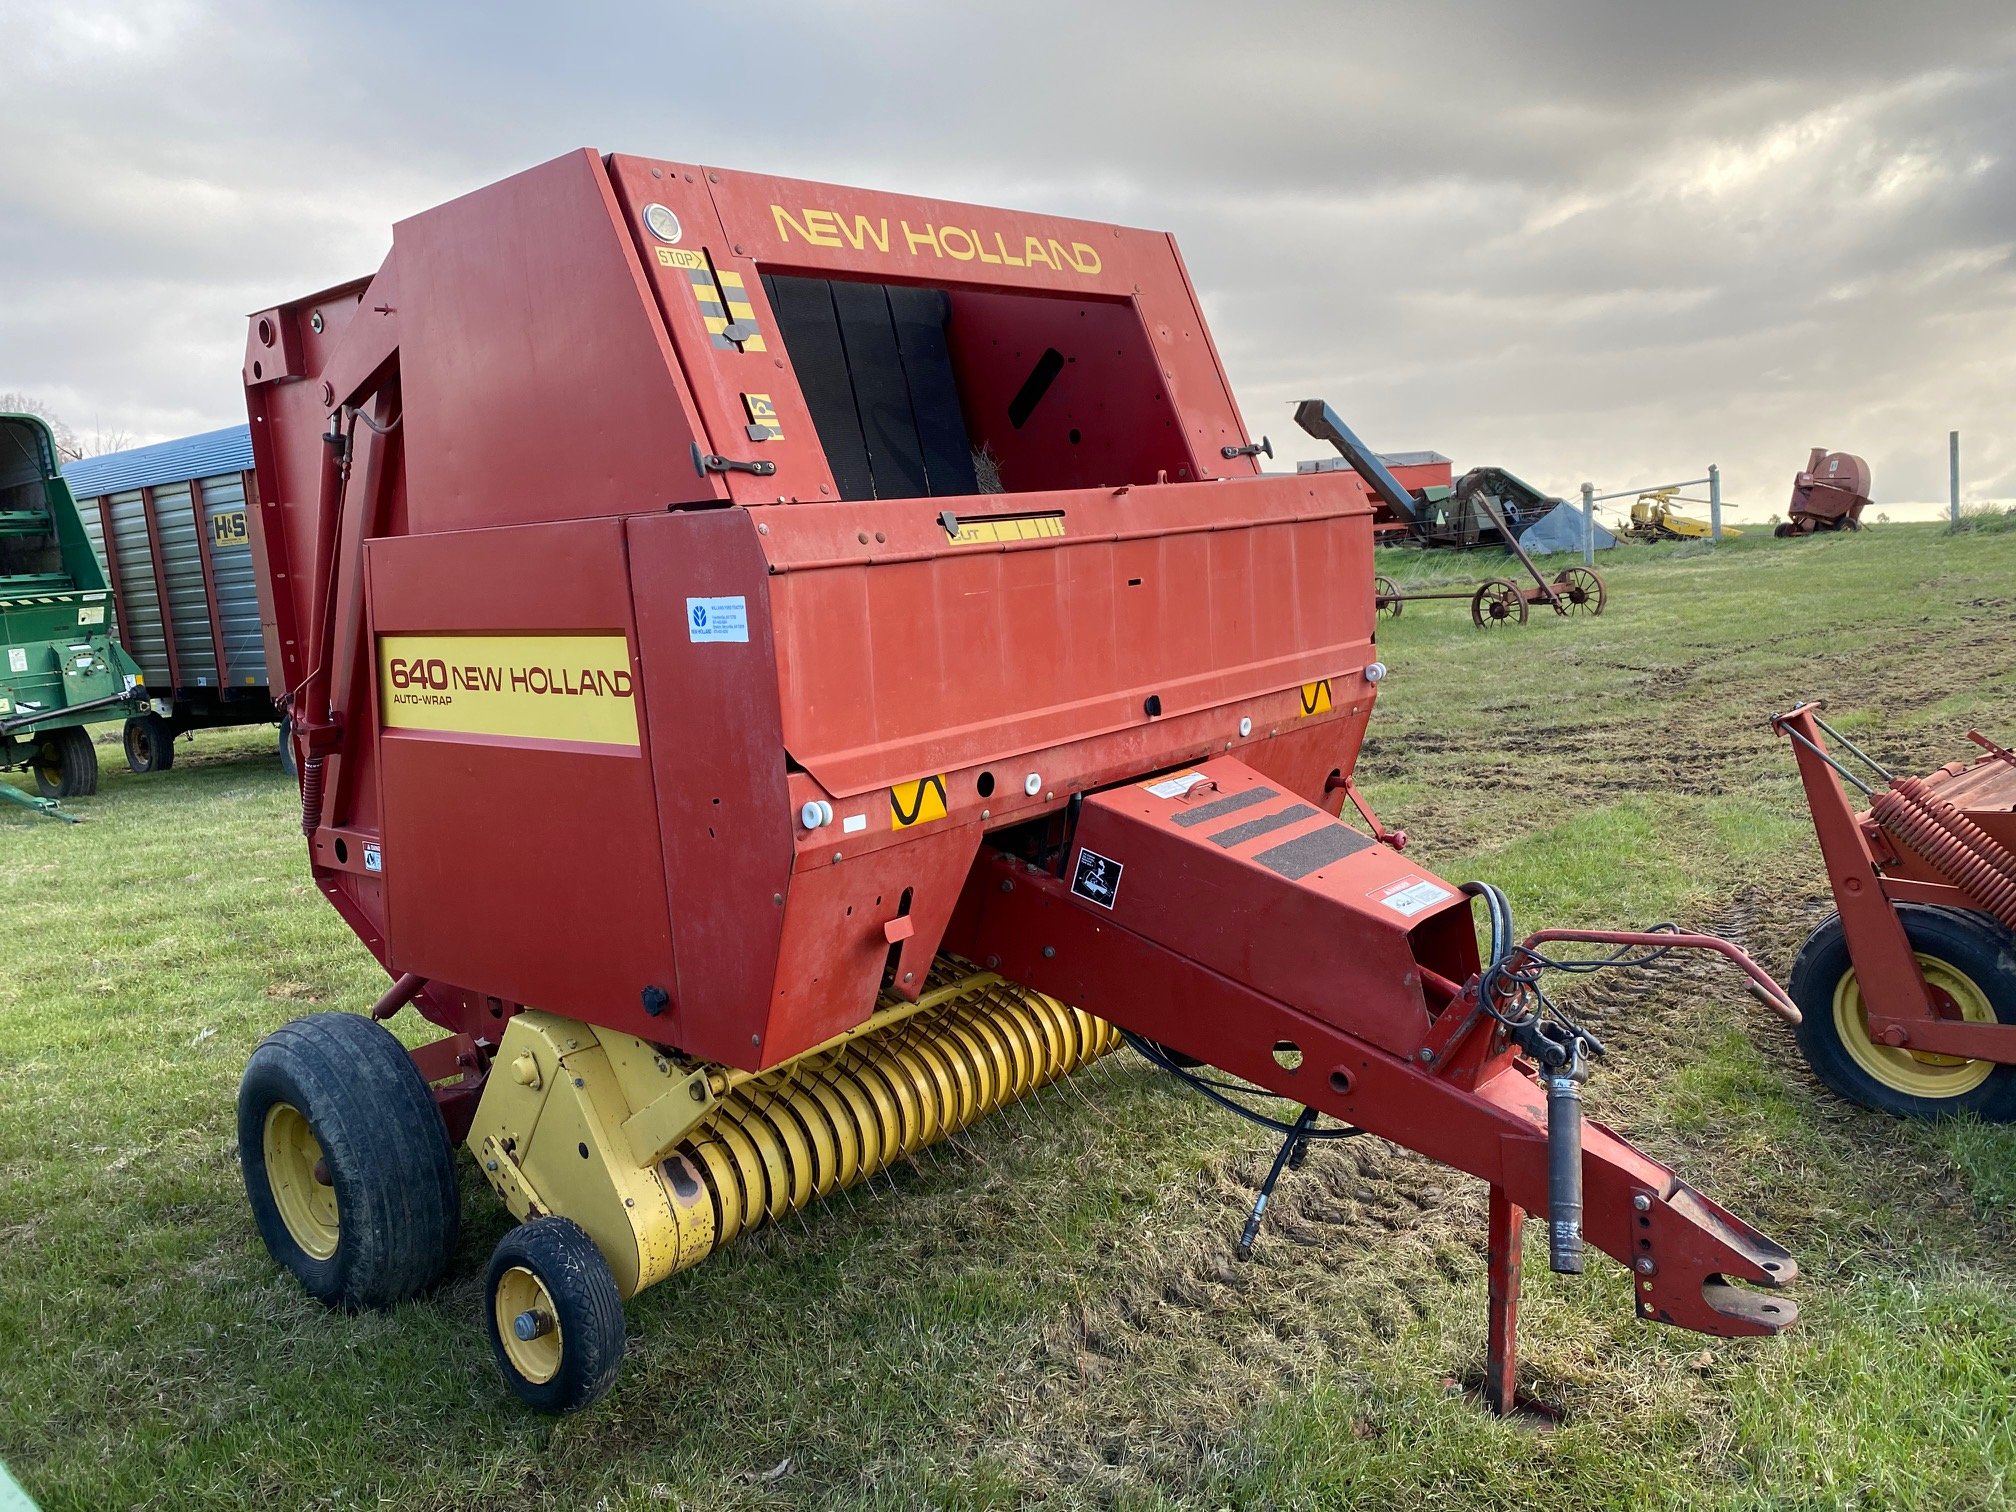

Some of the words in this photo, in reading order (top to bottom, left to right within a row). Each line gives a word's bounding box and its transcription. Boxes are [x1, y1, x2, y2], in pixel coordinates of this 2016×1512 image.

[770, 204, 889, 253] NEW
[901, 220, 1102, 275] HOLLAND
[658, 250, 693, 267] STOP
[213, 513, 246, 539] H&S
[389, 658, 449, 691] 640
[451, 666, 503, 692] NEW
[510, 666, 634, 698] HOLLAND
[393, 694, 453, 706] AUTO-WRAP
